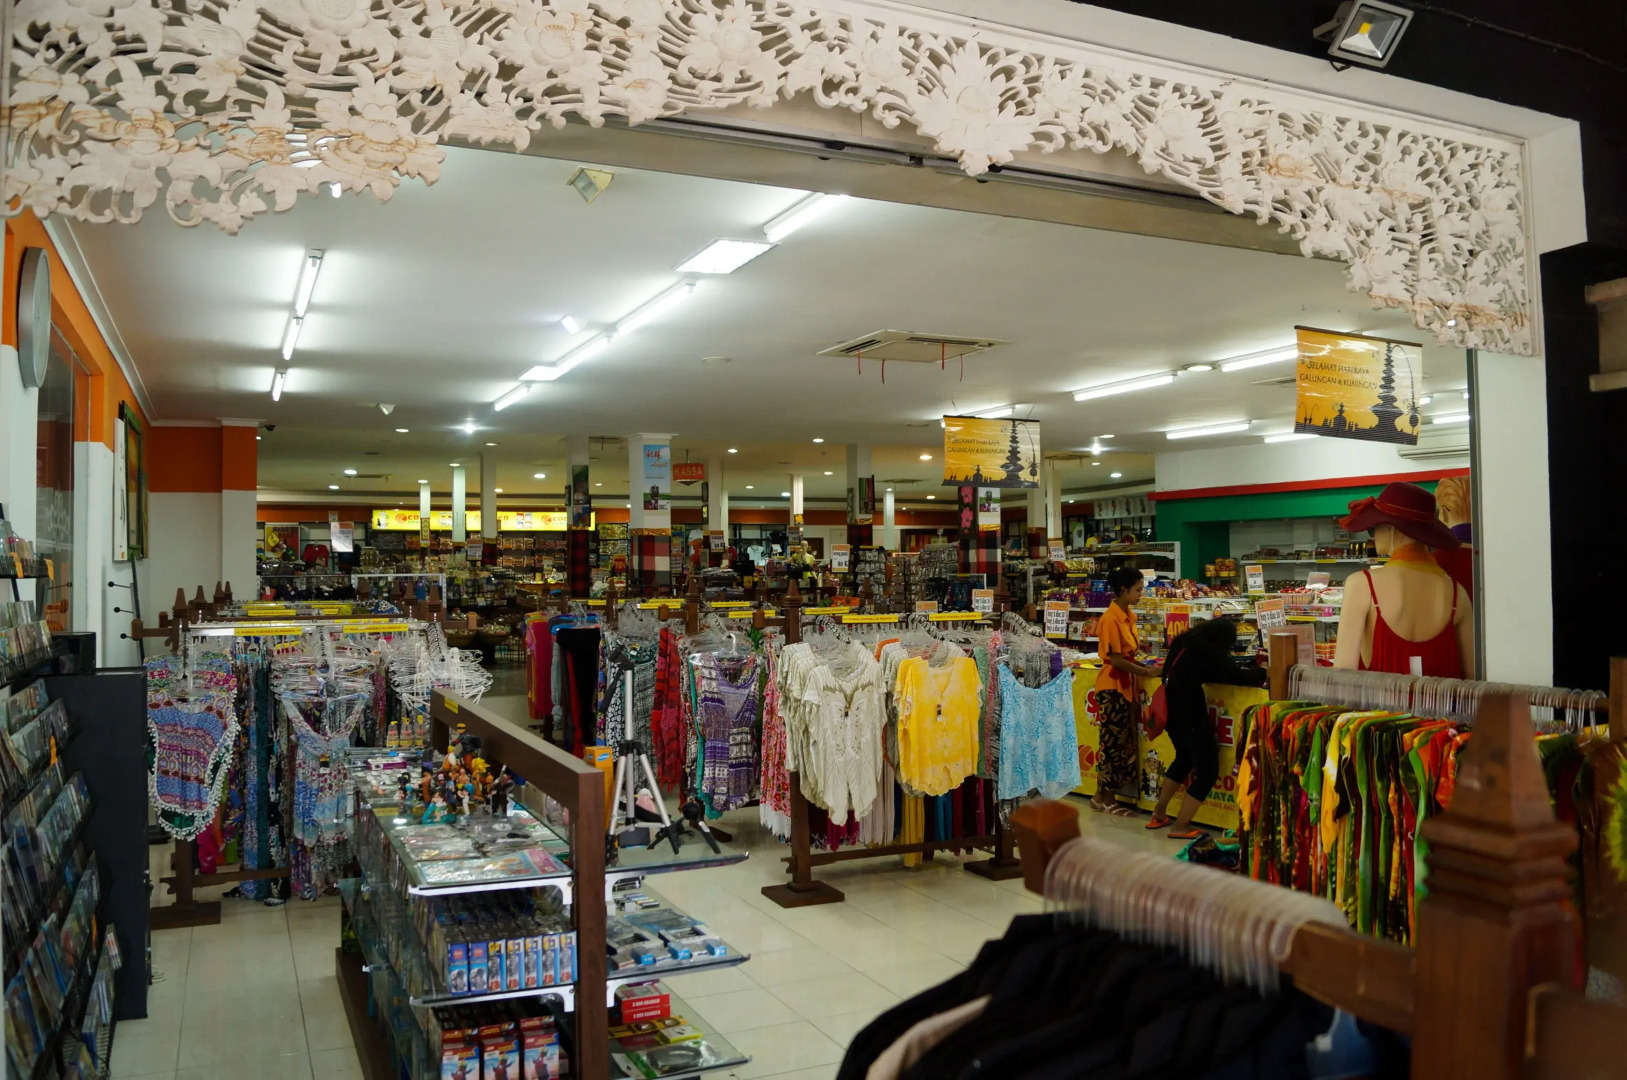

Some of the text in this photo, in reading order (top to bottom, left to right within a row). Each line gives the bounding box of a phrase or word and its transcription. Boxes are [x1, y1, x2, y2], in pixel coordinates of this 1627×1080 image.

[1306, 360, 1337, 372] SELAMAT
[1354, 366, 1369, 375] RAYA
[1343, 379, 1378, 390] KUNINGAN
[674, 466, 703, 476] KASSA
